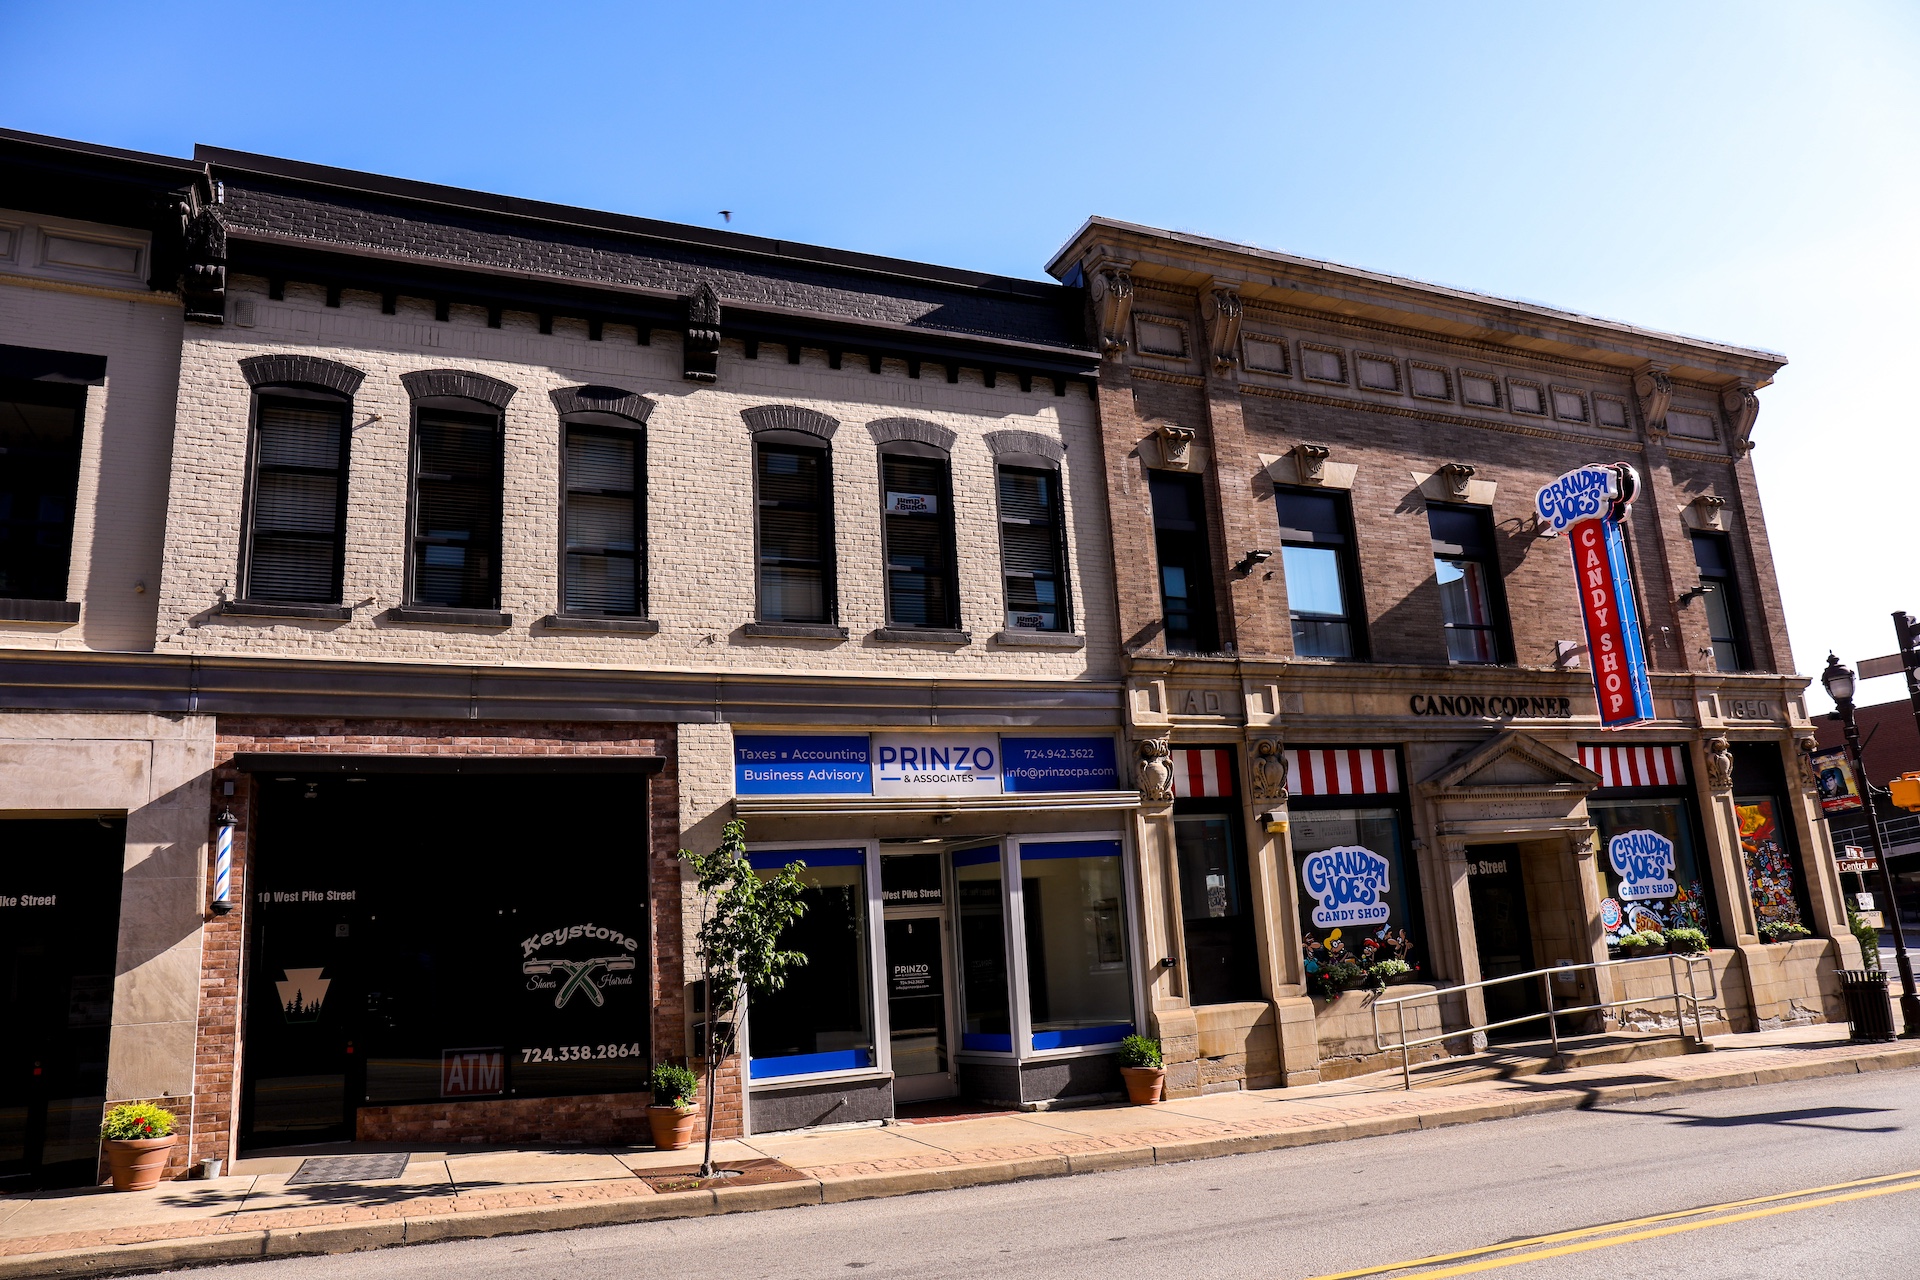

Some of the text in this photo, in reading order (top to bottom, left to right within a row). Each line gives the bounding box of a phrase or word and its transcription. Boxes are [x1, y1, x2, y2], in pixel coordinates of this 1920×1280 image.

[1539, 470, 1609, 518] GRANDPA
[1554, 489, 1601, 530] JOE'S
[1581, 528, 1623, 714] CANDY SHOP
[1410, 695, 1571, 718] CANON CORNER
[739, 748, 867, 762] Taxes Accounting
[879, 746, 994, 771] PRINZO
[1024, 749, 1094, 759] 724.942.3622
[744, 769, 865, 783] Business Advisory
[904, 774, 974, 783] & ASSOCIATES
[1006, 766, 1115, 779] info@prinzocpa.com
[1612, 834, 1671, 870] GRANDPA
[1308, 852, 1386, 893] GRANDPA
[1478, 859, 1508, 875] Street
[1626, 855, 1665, 884] JOE'S
[1841, 860, 1868, 871] Central
[258, 889, 356, 903] 10 West Pike Street
[901, 889, 918, 899] Pike
[919, 888, 942, 899] Street
[1324, 876, 1377, 910] JOE'S
[1621, 884, 1674, 896] CANDY SHOP
[20, 894, 57, 906] Street
[1317, 907, 1386, 922] CANDY SHOP
[520, 922, 638, 958] Keystone
[895, 963, 928, 974] PRINZO
[597, 973, 633, 988] Haircuts
[521, 1043, 640, 1063] 724.338.2864
[447, 1052, 500, 1092] ATM
